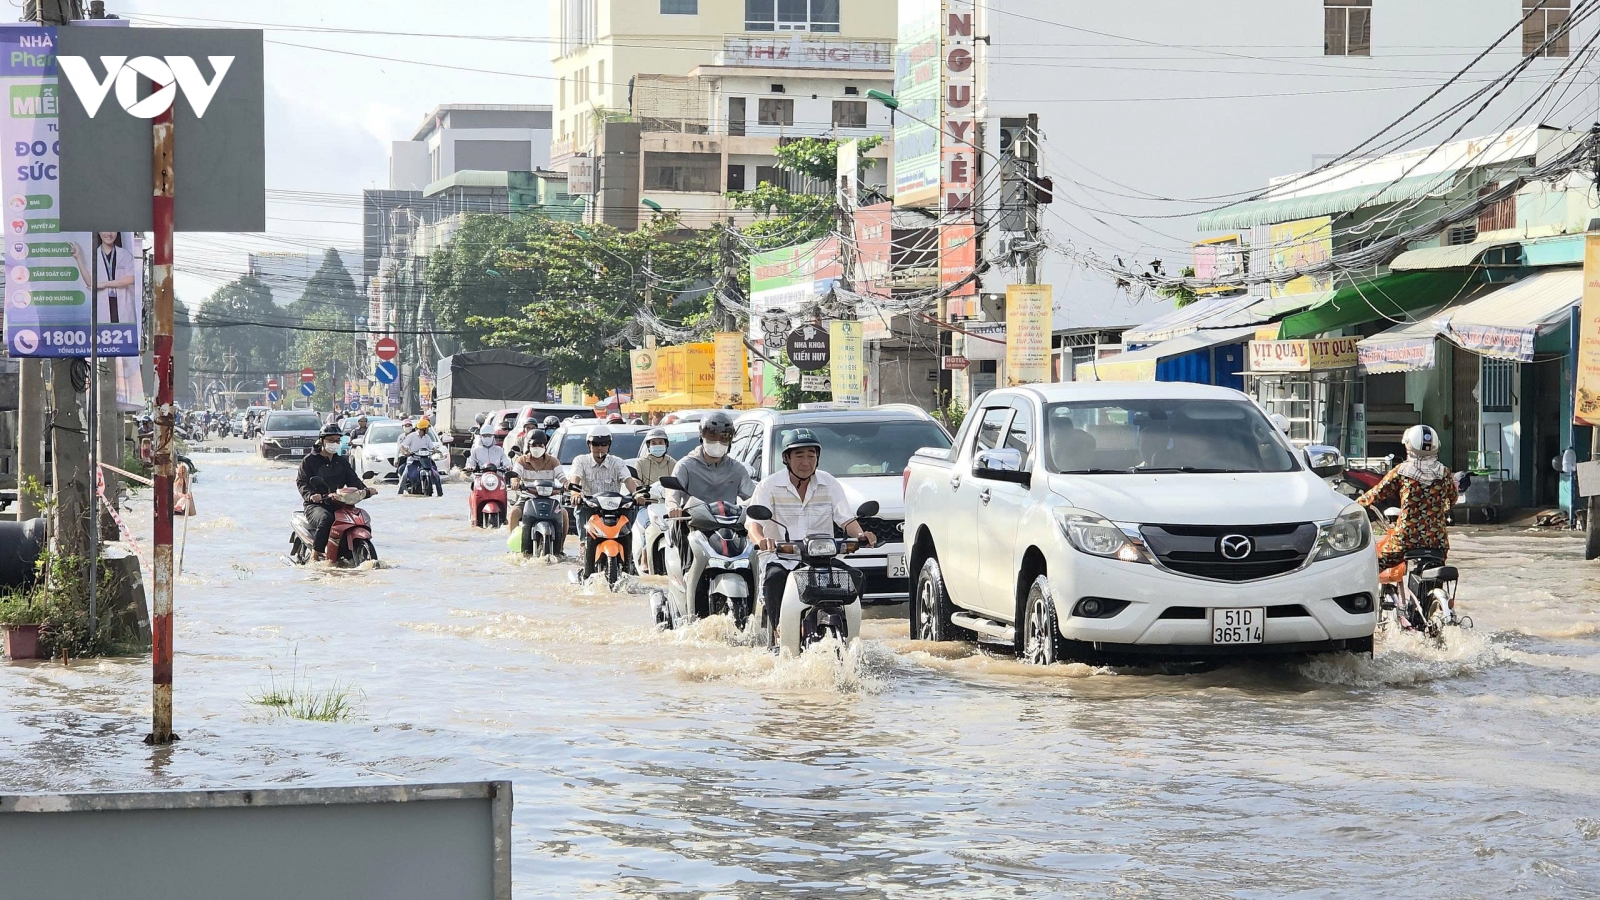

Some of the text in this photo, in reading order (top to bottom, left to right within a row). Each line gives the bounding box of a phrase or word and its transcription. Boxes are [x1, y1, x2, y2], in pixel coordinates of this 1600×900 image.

[20, 32, 53, 48] NHÀ
[13, 88, 59, 115] MIỄ
[15, 140, 47, 156] ĐO
[18, 161, 58, 181] SỨC
[43, 330, 87, 346] 1800
[794, 341, 826, 349] NHA KHOA
[793, 350, 826, 361] KIẾN HUY
[1253, 343, 1305, 361] VỊT QUAY
[1312, 342, 1330, 359] VỊT
[1225, 610, 1252, 626] 51D
[1214, 626, 1262, 643] 365.14
